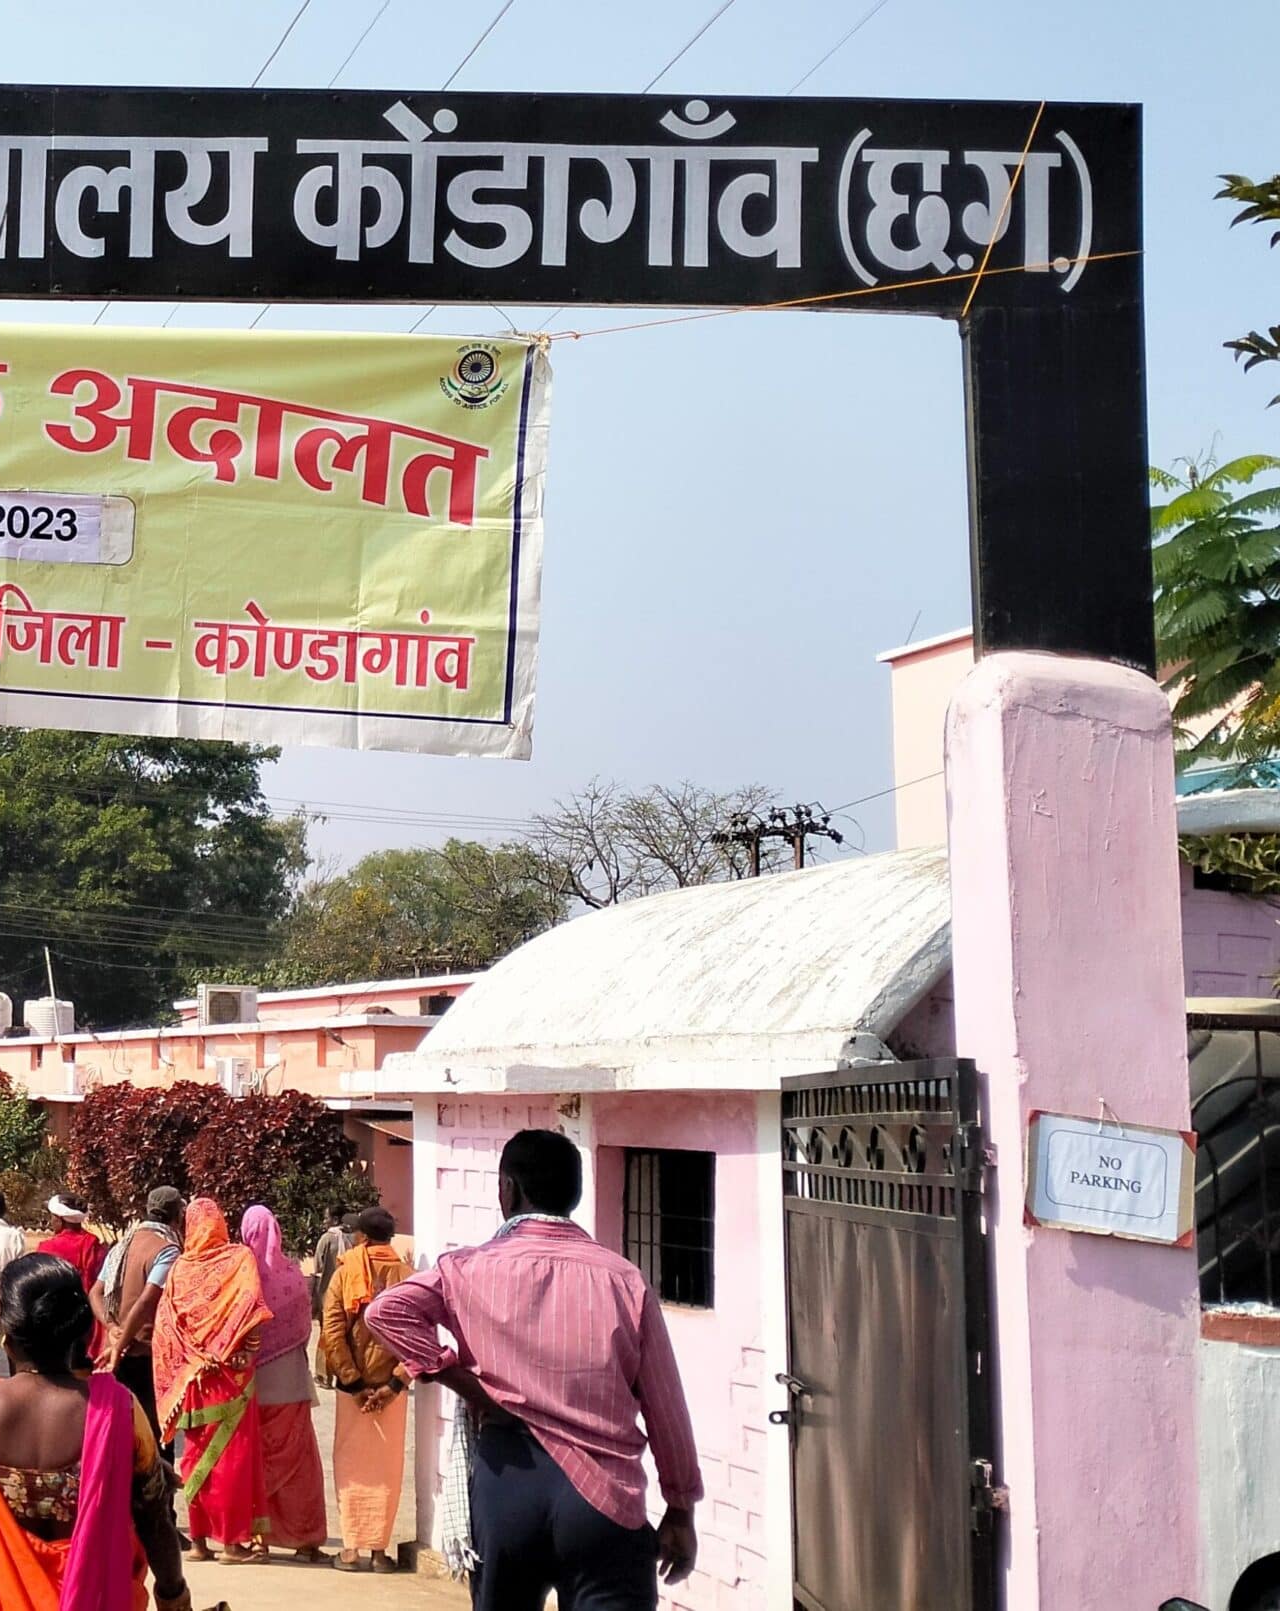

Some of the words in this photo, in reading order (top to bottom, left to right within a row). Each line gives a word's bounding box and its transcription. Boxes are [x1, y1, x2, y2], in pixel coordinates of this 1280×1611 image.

[293, 99, 820, 269] कोंडागाँव
[44, 369, 490, 526] अदालत
[194, 601, 476, 690] कोण्डागांव
[1070, 1171, 1143, 1194] PARKING
[1098, 1155, 1122, 1170] NO
